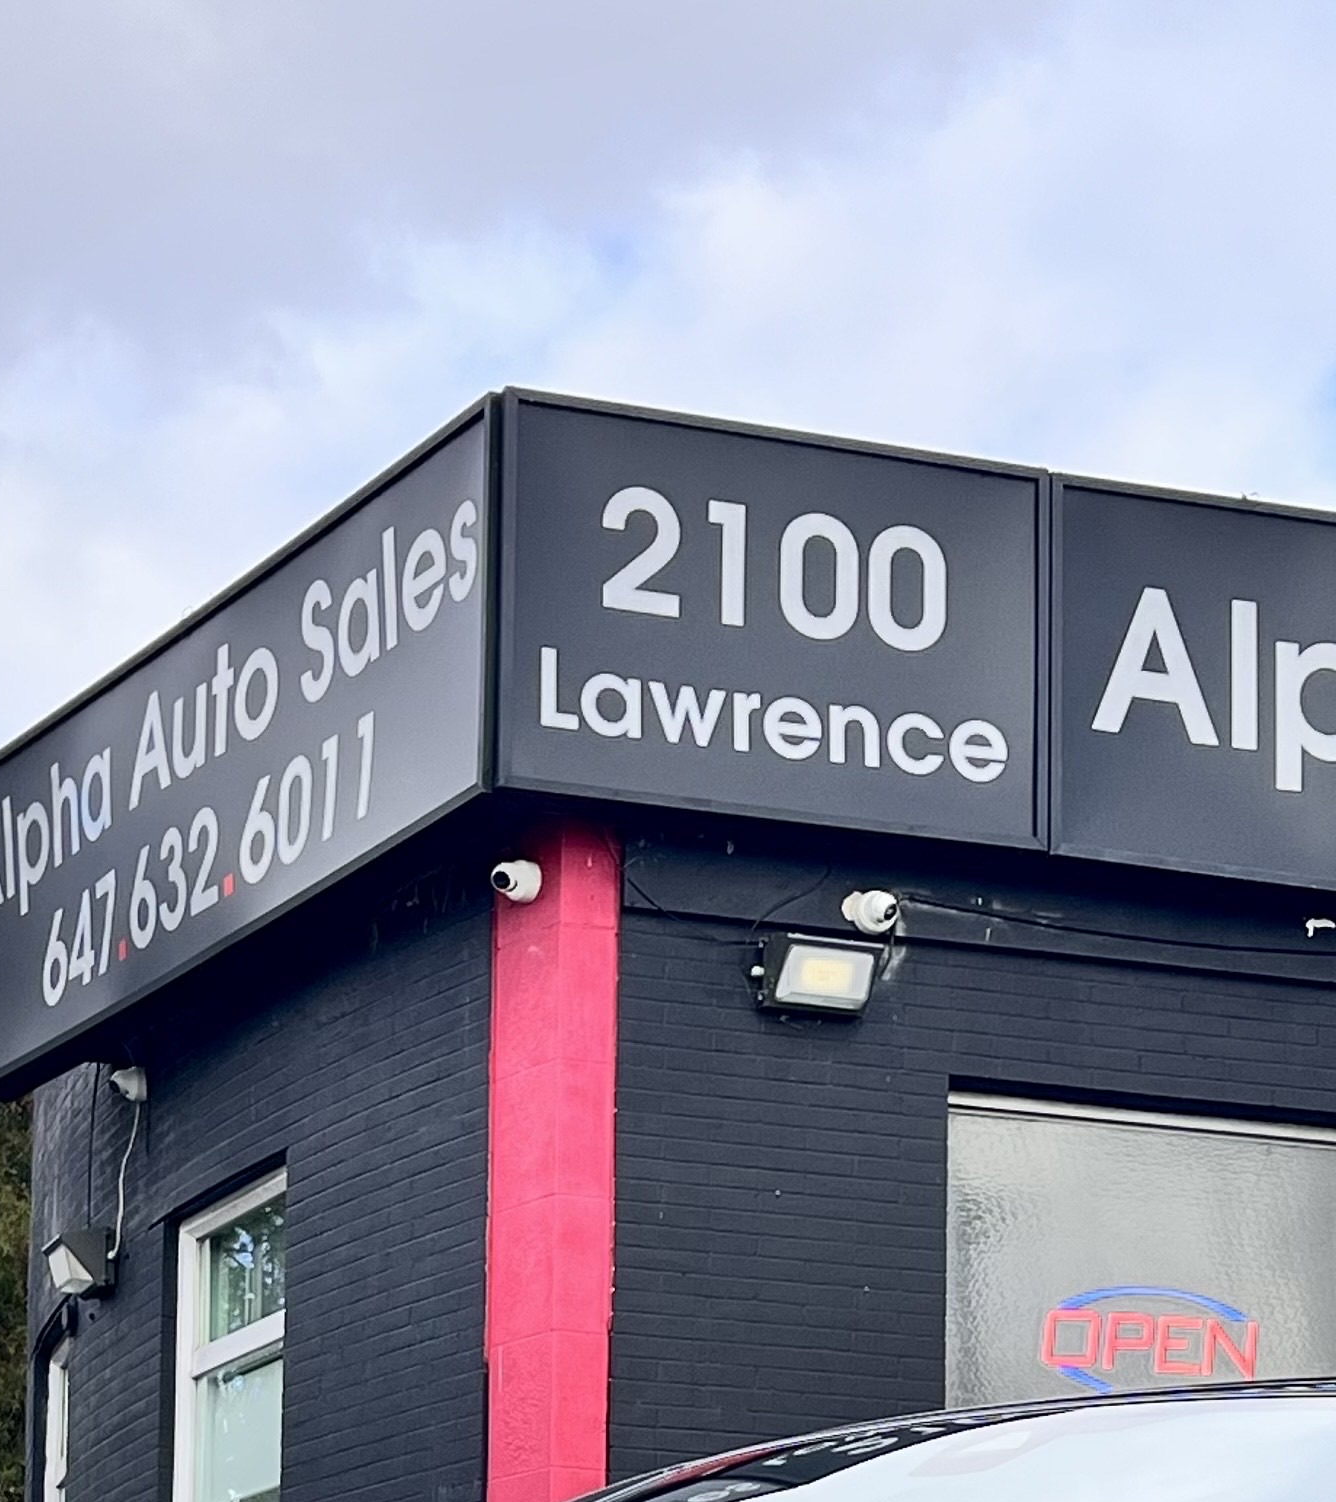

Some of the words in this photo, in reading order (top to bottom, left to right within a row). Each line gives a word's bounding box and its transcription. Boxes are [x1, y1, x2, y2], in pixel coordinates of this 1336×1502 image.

[600, 485, 948, 652] 2100
[128, 643, 279, 811] Auto
[299, 499, 479, 703] Sales
[538, 645, 1010, 784] Lawrence
[41, 710, 376, 1007] 647.632.6011
[1039, 1307, 1258, 1382] OPEN
